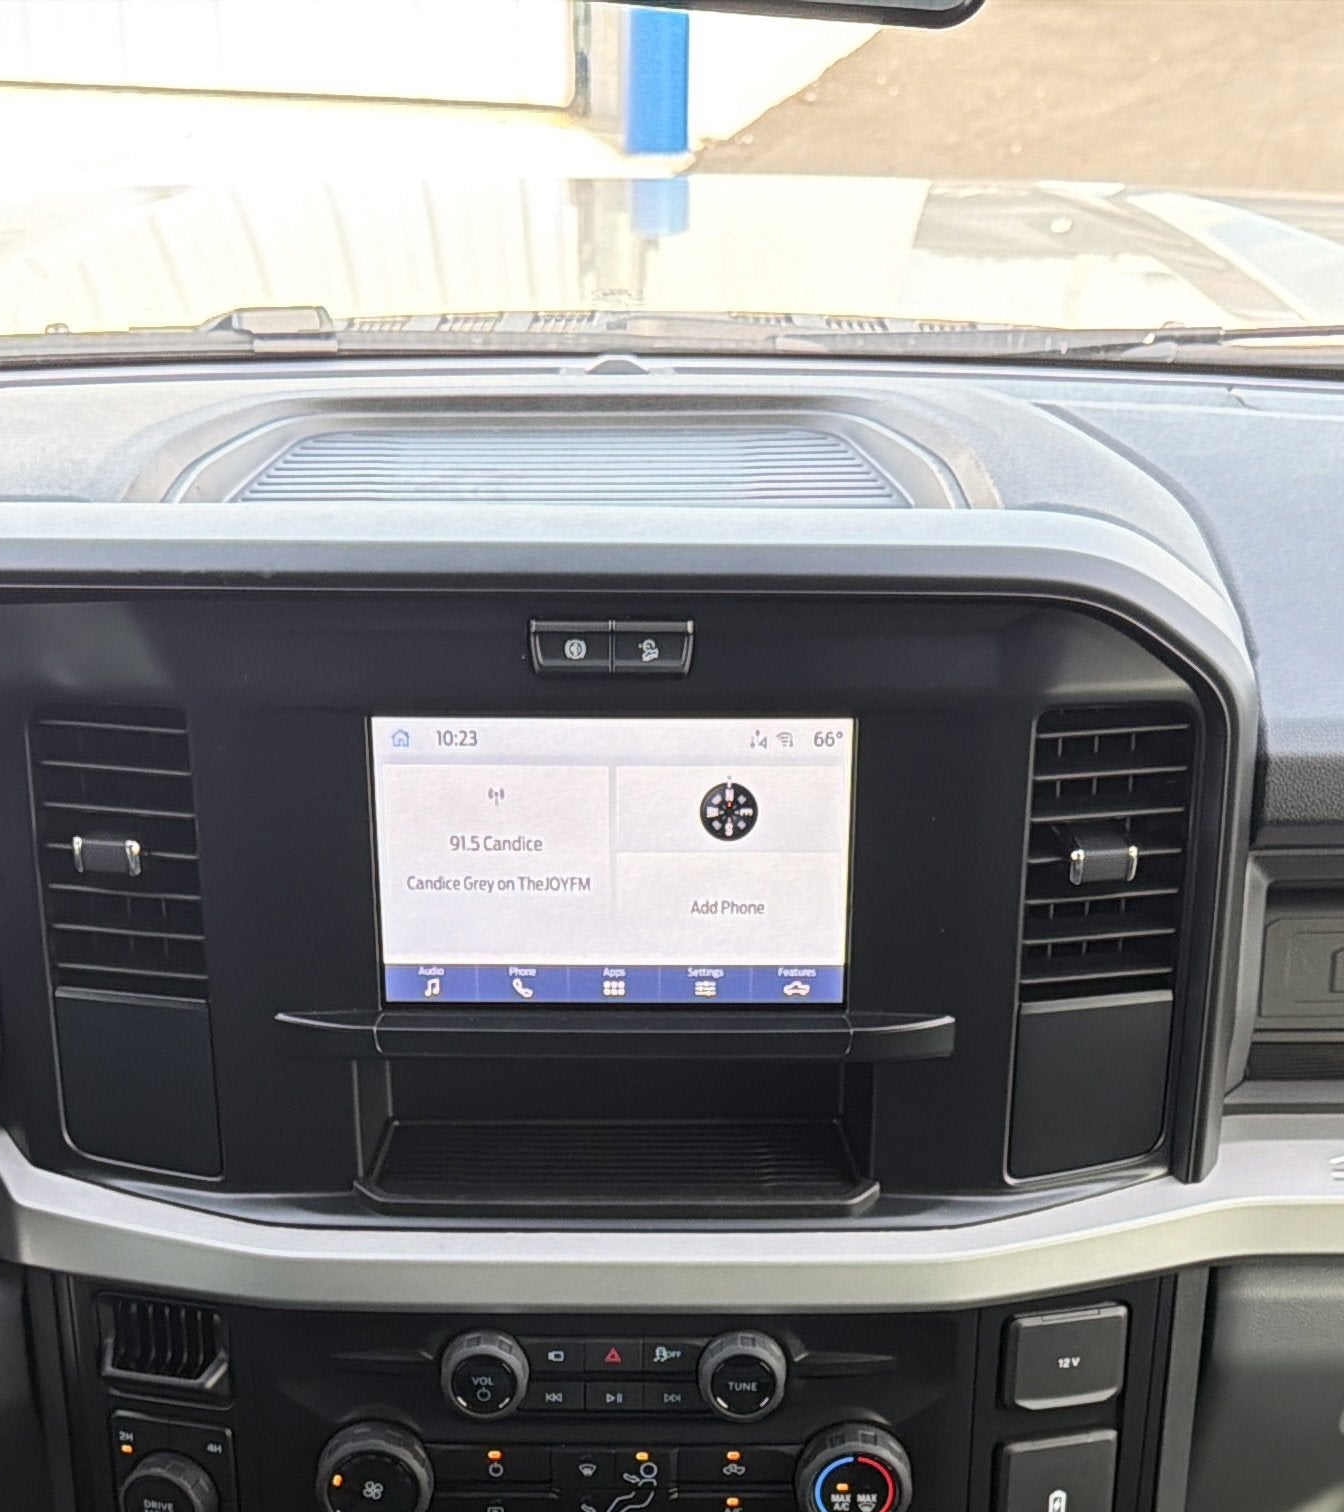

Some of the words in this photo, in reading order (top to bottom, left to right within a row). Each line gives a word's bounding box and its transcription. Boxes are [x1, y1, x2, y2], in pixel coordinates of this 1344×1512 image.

[436, 730, 478, 747] 10:23
[449, 836, 481, 852] 91.5
[483, 836, 544, 852] Candice
[406, 876, 462, 892] Candice
[463, 876, 495, 895] Grey
[497, 879, 516, 892] on
[690, 900, 719, 915] Add
[721, 900, 766, 915] Phone
[418, 966, 445, 977] Audio
[509, 966, 537, 977] Phone
[603, 966, 626, 979] Apps
[687, 966, 725, 979] Settings
[777, 966, 817, 977] Features
[471, 1376, 494, 1386] VOL
[727, 1381, 758, 1392] TUNE
[119, 1430, 134, 1442] 2H
[206, 1443, 223, 1455] 4H
[830, 1493, 852, 1503] MAX
[856, 1493, 878, 1503] MAX
[143, 1499, 174, 1512] DRIVE
[833, 1502, 851, 1512] A/C
